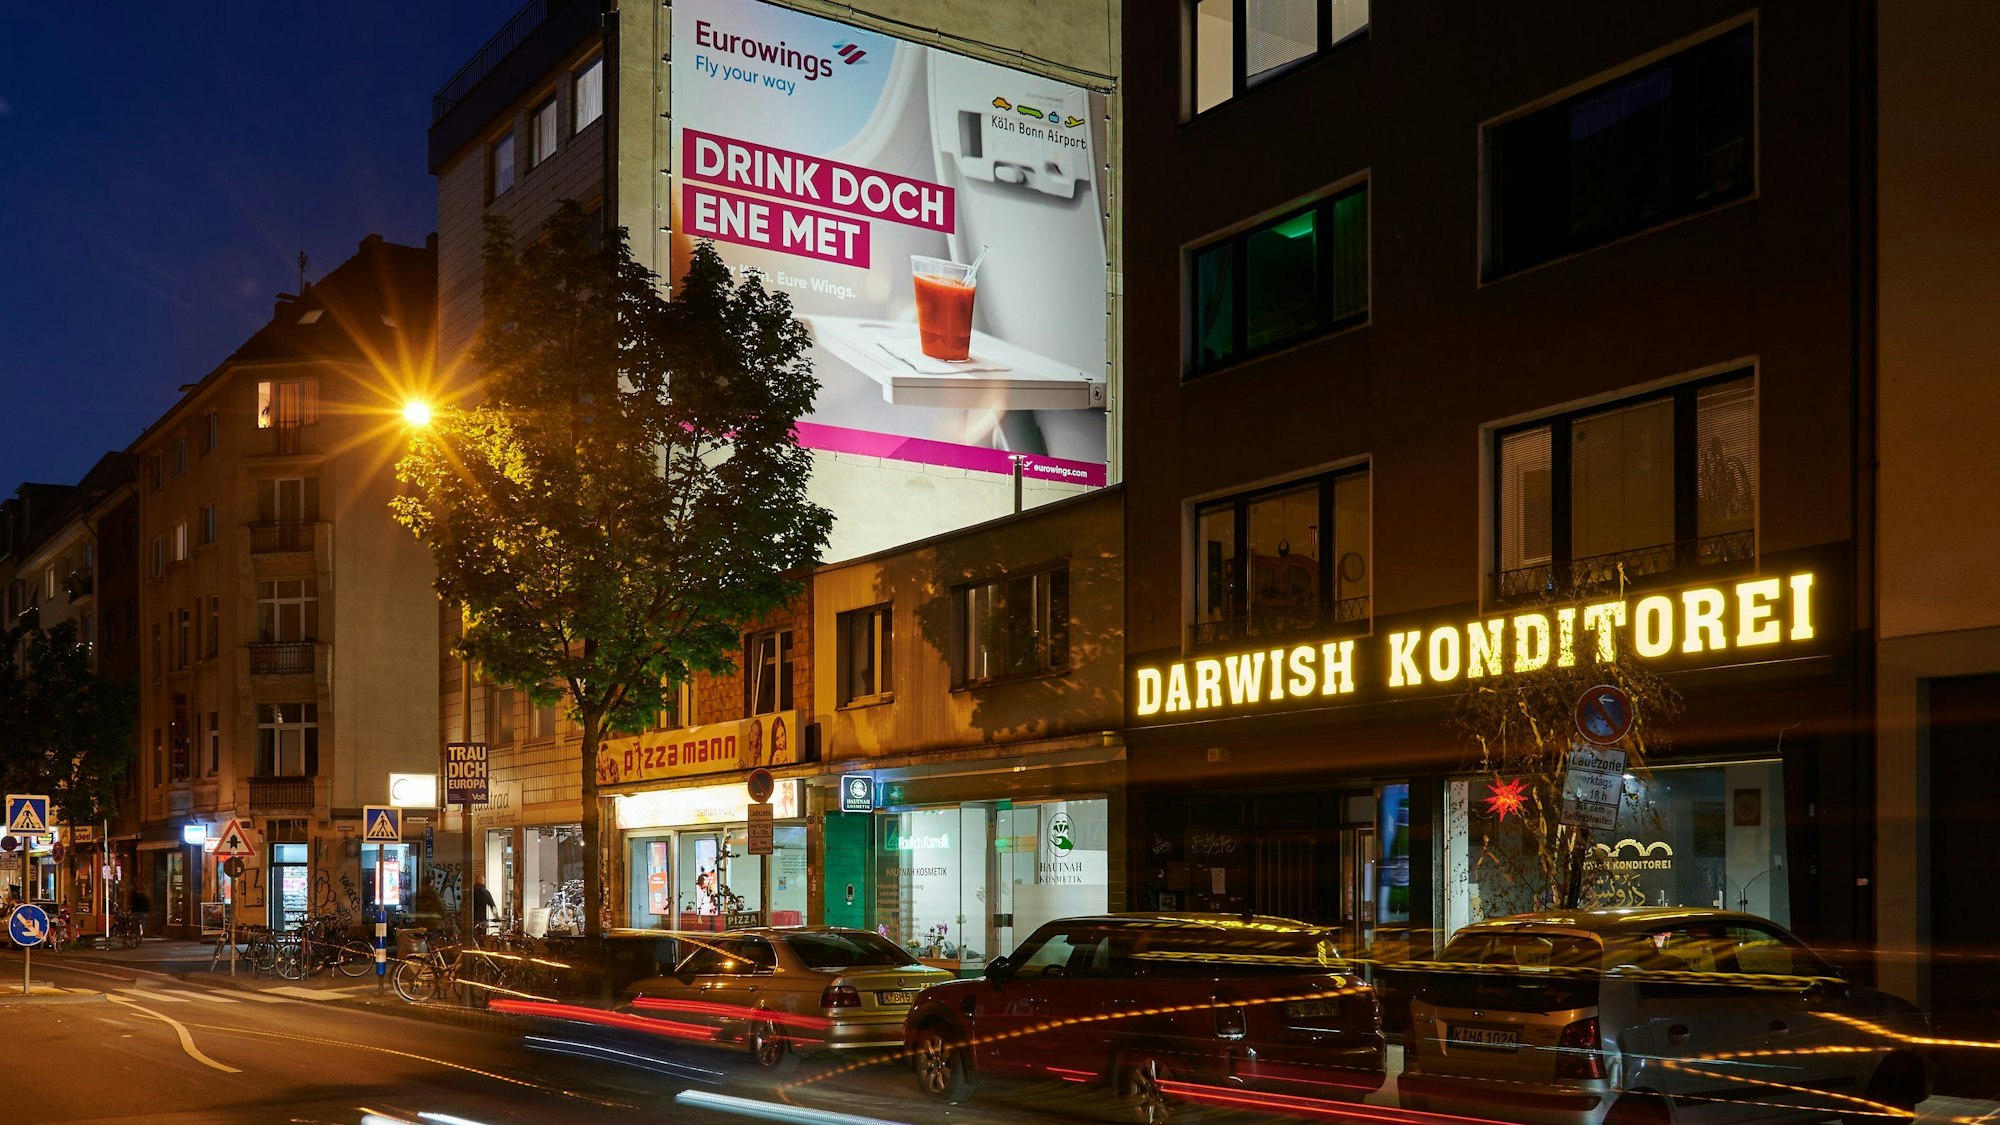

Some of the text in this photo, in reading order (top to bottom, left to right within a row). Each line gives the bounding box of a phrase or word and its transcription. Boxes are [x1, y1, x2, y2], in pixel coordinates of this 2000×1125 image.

[696, 20, 833, 81] Eurowings
[696, 55, 796, 96] Fly your way
[991, 115, 1087, 150] Köln Bonn Airport
[695, 136, 944, 227] DRINK DOCH
[695, 193, 860, 260] ENE MET
[777, 271, 808, 289] Eure
[810, 277, 857, 300] Wings.
[1034, 464, 1088, 479] eurowings.com
[1136, 572, 1816, 717] DARWISH KONDITOREI
[448, 746, 487, 761] TRAU
[682, 735, 737, 765] mann
[448, 761, 487, 779] DICH
[448, 779, 487, 790] EUROPA
[472, 792, 487, 801] Volt
[1590, 788, 1600, 801] 18
[1601, 790, 1607, 801] h
[885, 867, 948, 877] HAUTNAH KOSMETIK
[1039, 862, 1082, 872] HAUTNAH
[1613, 859, 1672, 870] KONDITOREI
[1039, 875, 1082, 883] KOSMETIK
[727, 914, 758, 926] PIZZA
